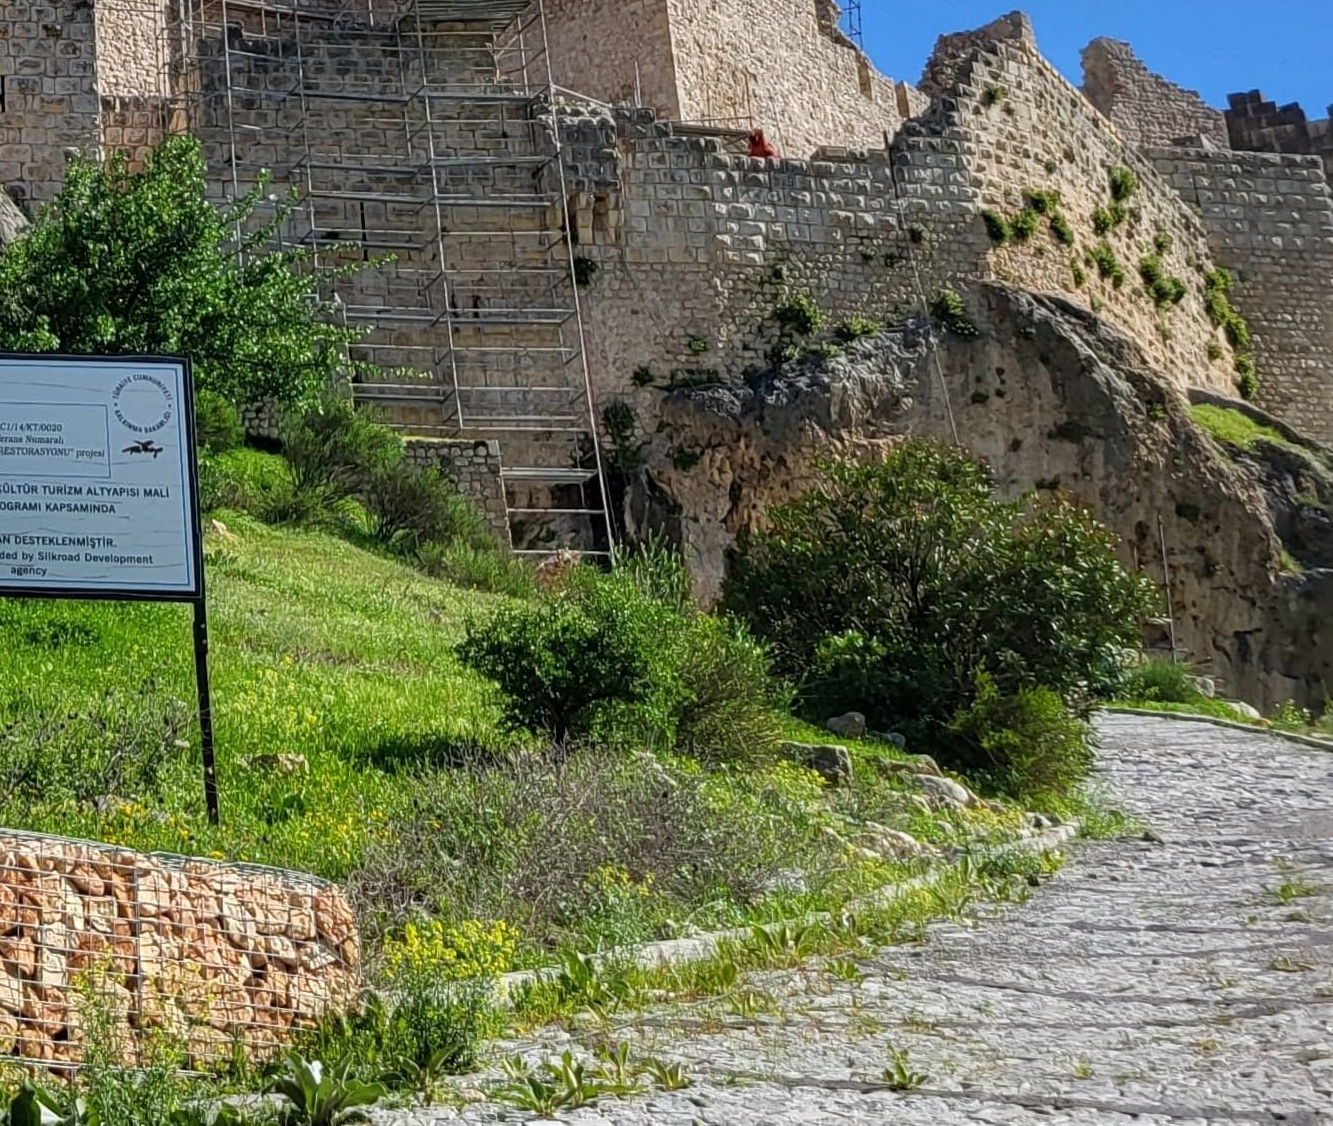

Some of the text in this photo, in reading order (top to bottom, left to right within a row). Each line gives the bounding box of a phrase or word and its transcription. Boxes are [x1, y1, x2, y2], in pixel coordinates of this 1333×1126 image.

[25, 435, 64, 444] Numaralı
[76, 450, 105, 458] projesi
[41, 484, 82, 496] TURİZM
[86, 486, 139, 497] ALTYAPISI
[143, 486, 169, 498] MALİ
[45, 502, 115, 514] KAPSAMINDA
[14, 535, 117, 549] DESTEKLENMİŞTİR.
[21, 551, 34, 562] by
[37, 552, 81, 562] Silkroad
[85, 553, 153, 564] Development
[11, 566, 47, 577] agency
